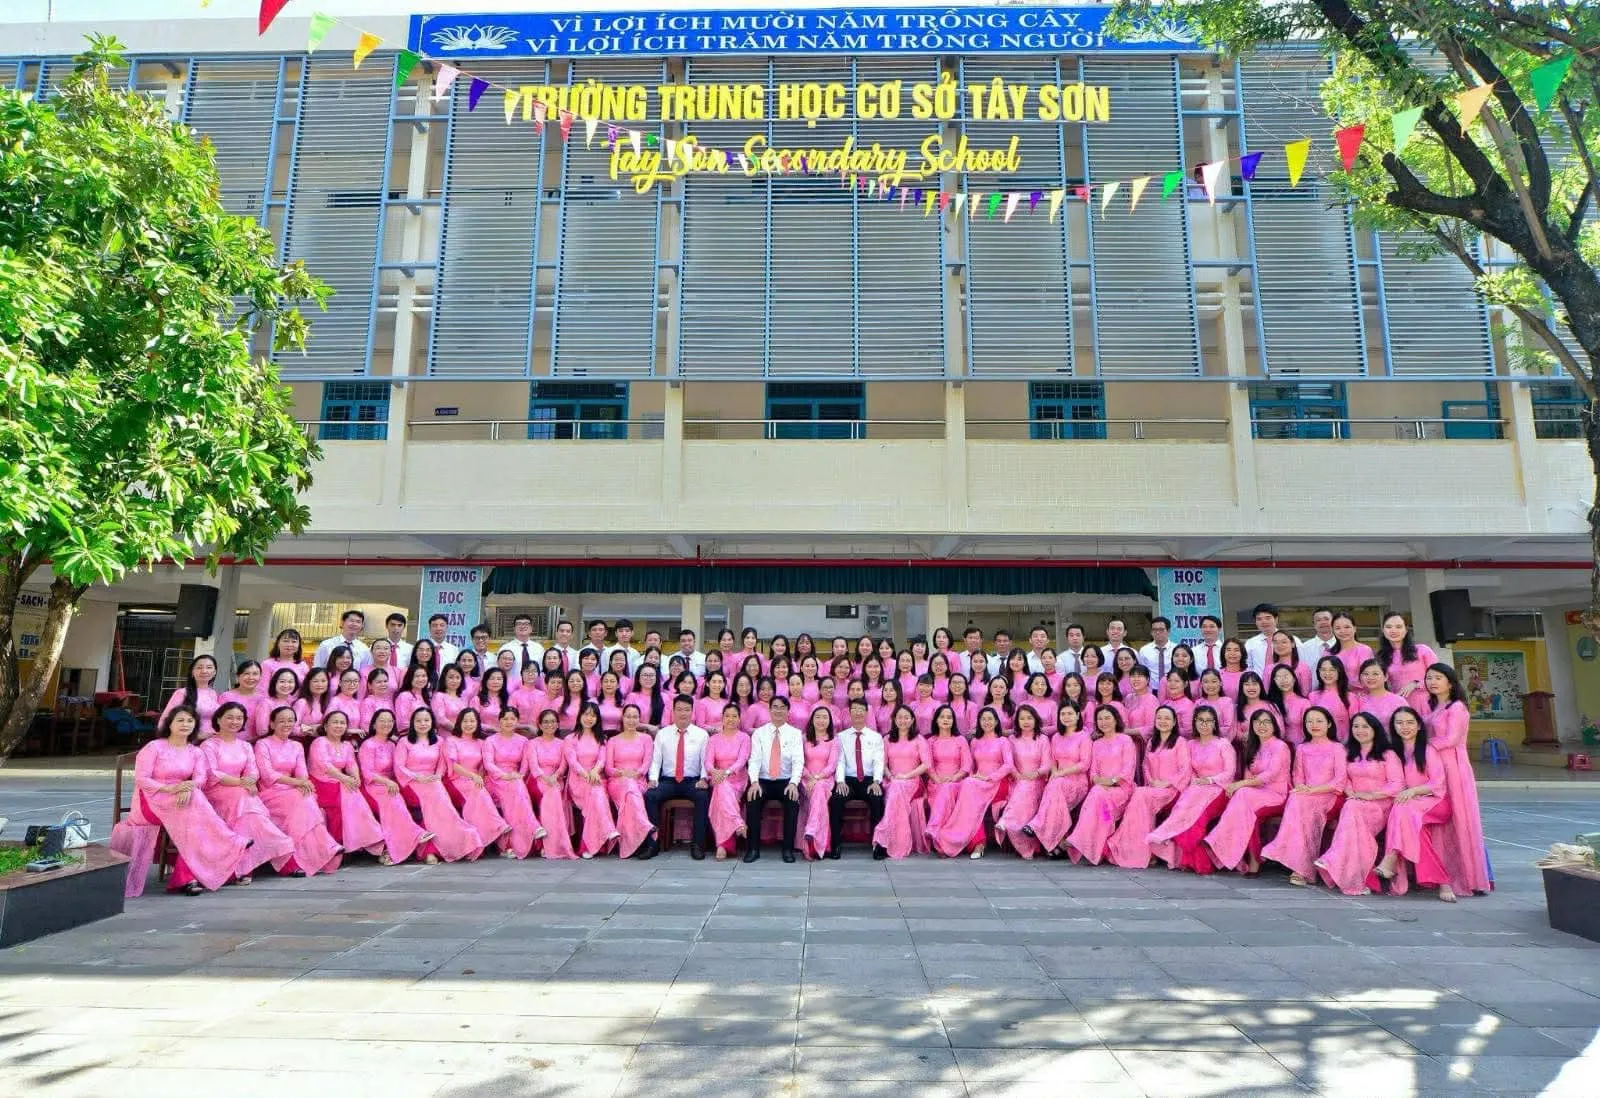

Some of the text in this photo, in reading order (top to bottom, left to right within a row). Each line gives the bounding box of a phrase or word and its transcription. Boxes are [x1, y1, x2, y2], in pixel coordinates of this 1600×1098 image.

[551, 8, 1082, 35] VÌ LỢI ÍCH MƯỜI NĂM TRỒNG CÂY
[526, 26, 1106, 55] VÌ LỢI ÍCH TRĂM NĂM TRỒNG NGƯỜI
[519, 72, 1110, 128] TRƯỜNG TRUNG HỌC CƠ SỞ TÂY SƠN
[743, 135, 922, 193] Secondary
[920, 135, 1021, 174] School
[1174, 570, 1204, 586] HỌC
[1174, 592, 1207, 606] SINH
